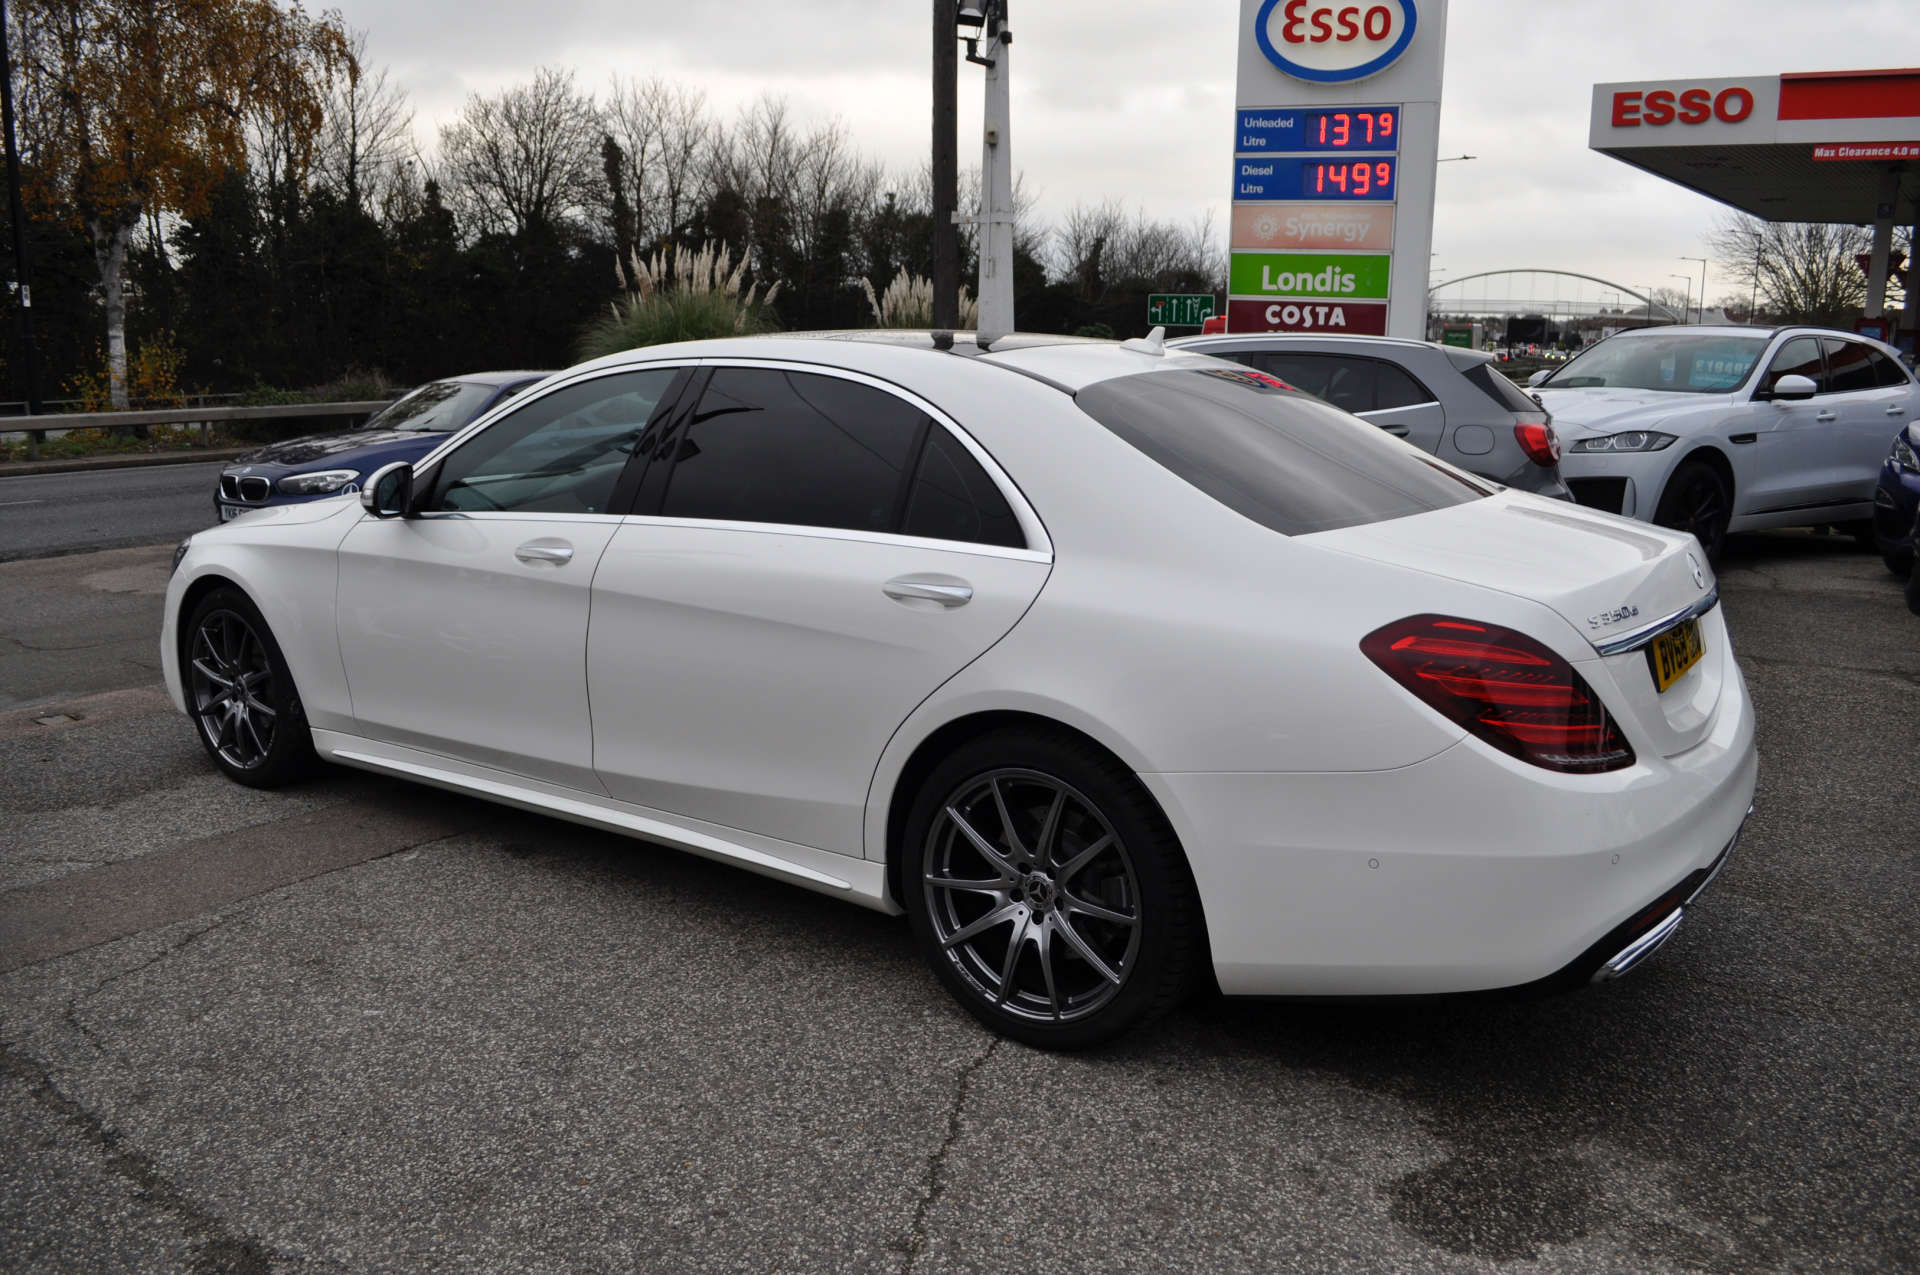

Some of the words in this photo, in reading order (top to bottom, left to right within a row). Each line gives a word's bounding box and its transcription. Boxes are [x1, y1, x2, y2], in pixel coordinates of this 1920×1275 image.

[1611, 87, 1754, 127] ESSO
[1244, 117, 1294, 128] Unleaded
[1243, 136, 1266, 146] Litre
[1815, 148, 1835, 157] Max
[1839, 147, 1890, 156] Clearance
[1241, 165, 1273, 176] Diesel
[1240, 183, 1264, 194] Litre
[1284, 218, 1371, 242] Synergy
[1262, 265, 1356, 292] Londis
[1265, 305, 1346, 328] COSTA
